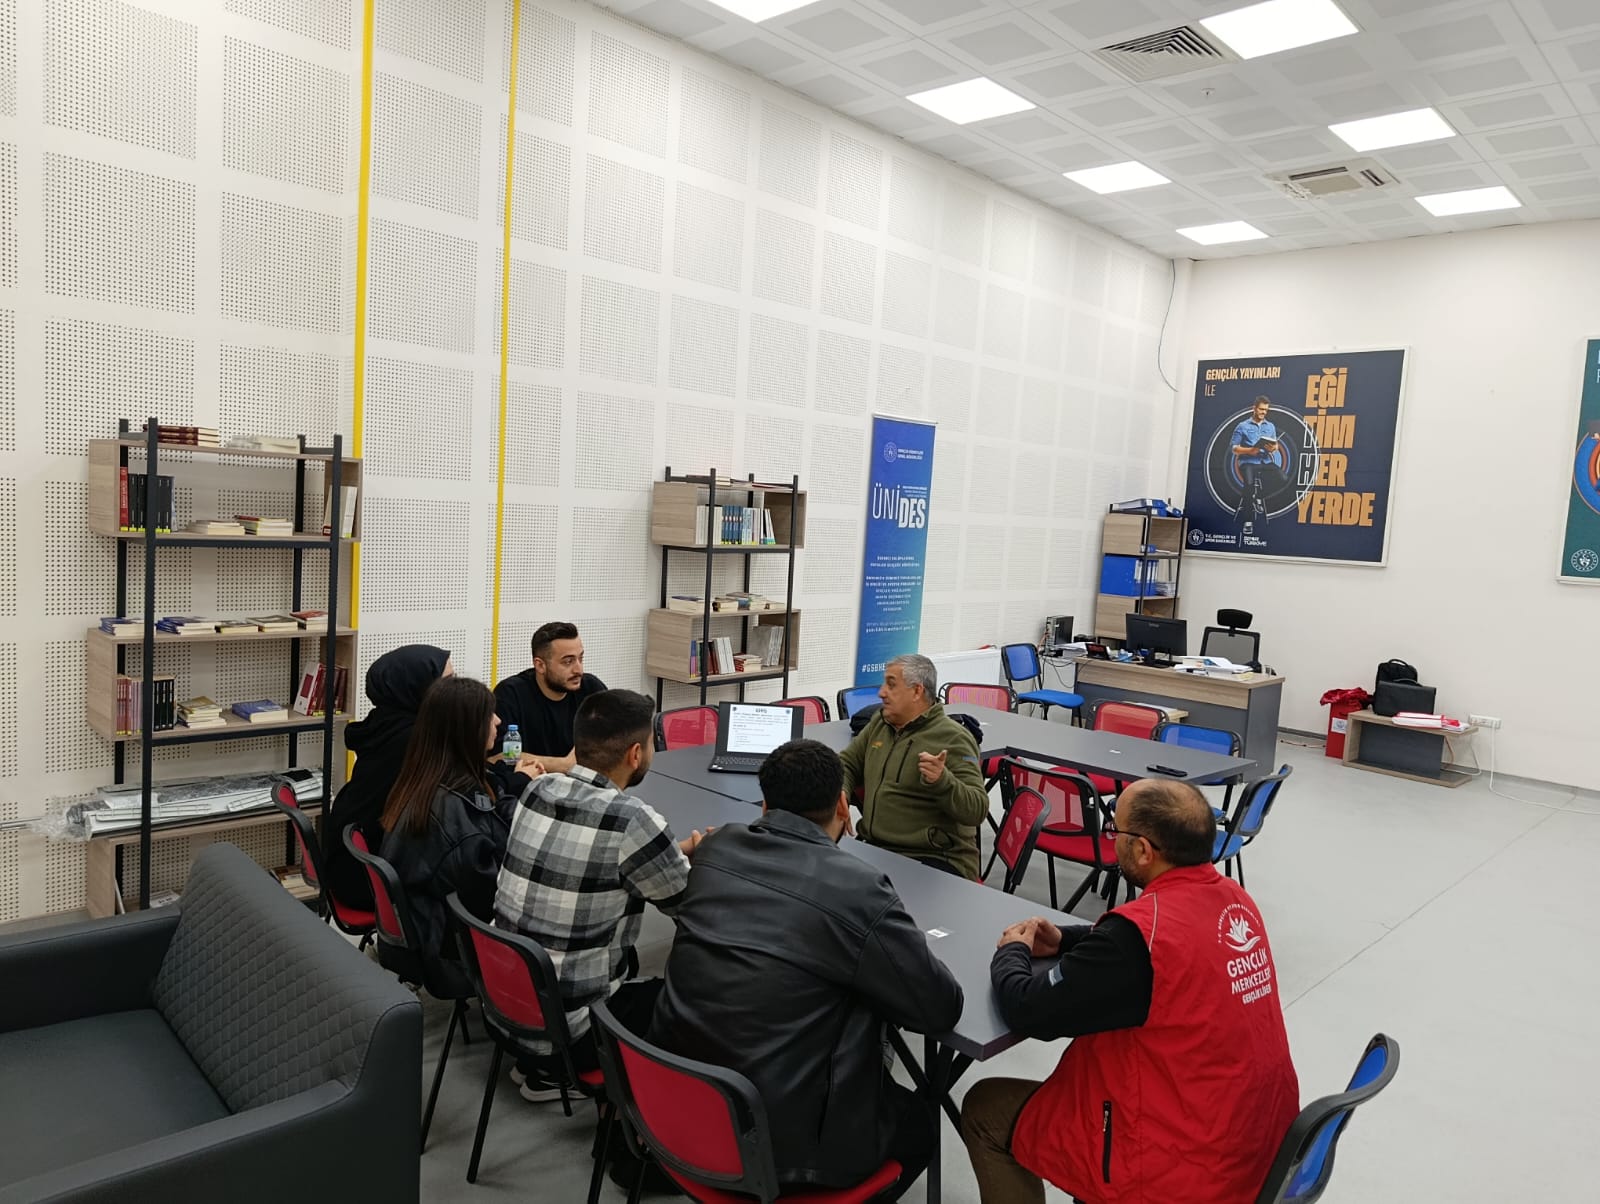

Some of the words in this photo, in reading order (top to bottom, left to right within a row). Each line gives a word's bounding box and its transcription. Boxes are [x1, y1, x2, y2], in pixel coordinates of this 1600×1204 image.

[1204, 383, 1216, 397] İLE
[1205, 367, 1238, 382] GENÇLİK
[1239, 366, 1281, 379] YAYINLARI
[1305, 367, 1348, 409] EĞİ
[1303, 408, 1357, 449] TİM
[1297, 453, 1348, 487] HER
[1296, 490, 1376, 527] YERDE
[861, 663, 886, 673] #GSBHE
[1227, 948, 1268, 978] GENÇLİK
